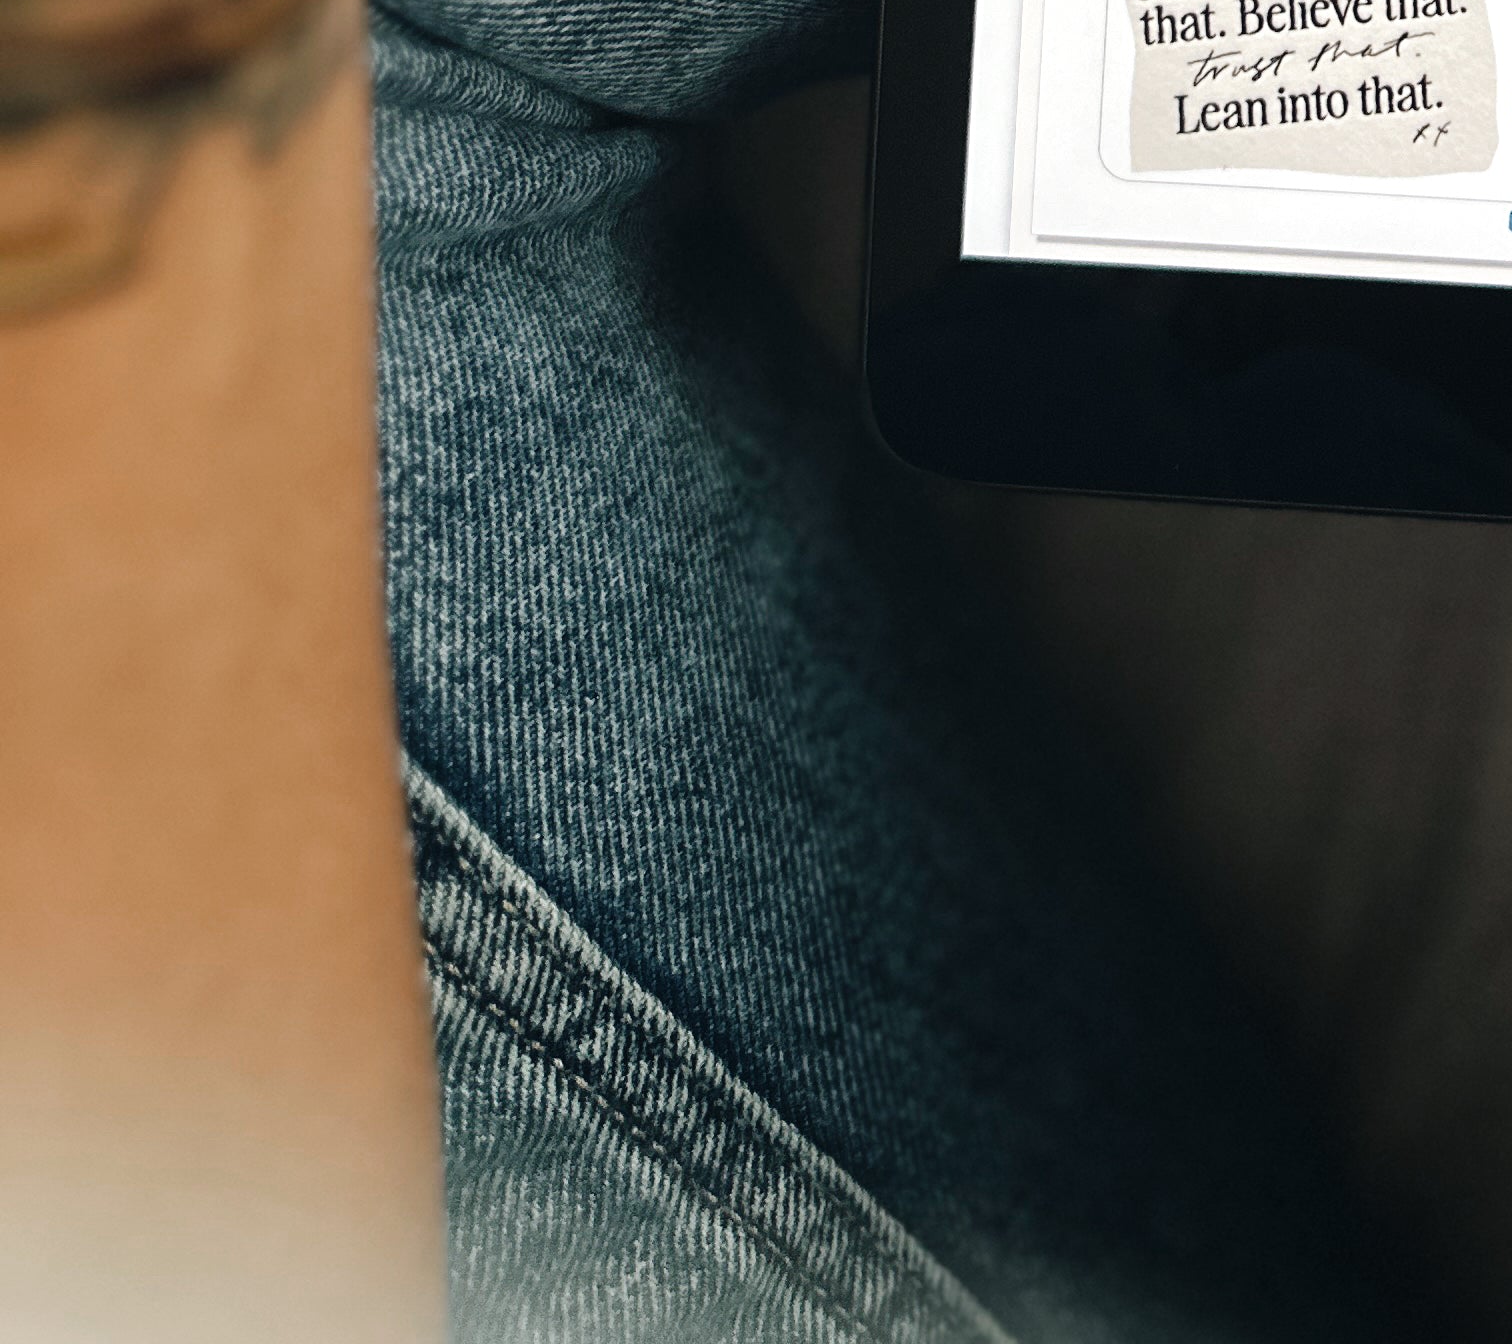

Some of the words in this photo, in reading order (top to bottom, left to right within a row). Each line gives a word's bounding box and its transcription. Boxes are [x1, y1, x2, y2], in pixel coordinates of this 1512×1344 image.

[1140, 6, 1227, 46] that.
[1187, 48, 1297, 87] trust
[1174, 92, 1269, 135] Lean
[1277, 86, 1350, 125] into
[1357, 74, 1444, 114] that.
